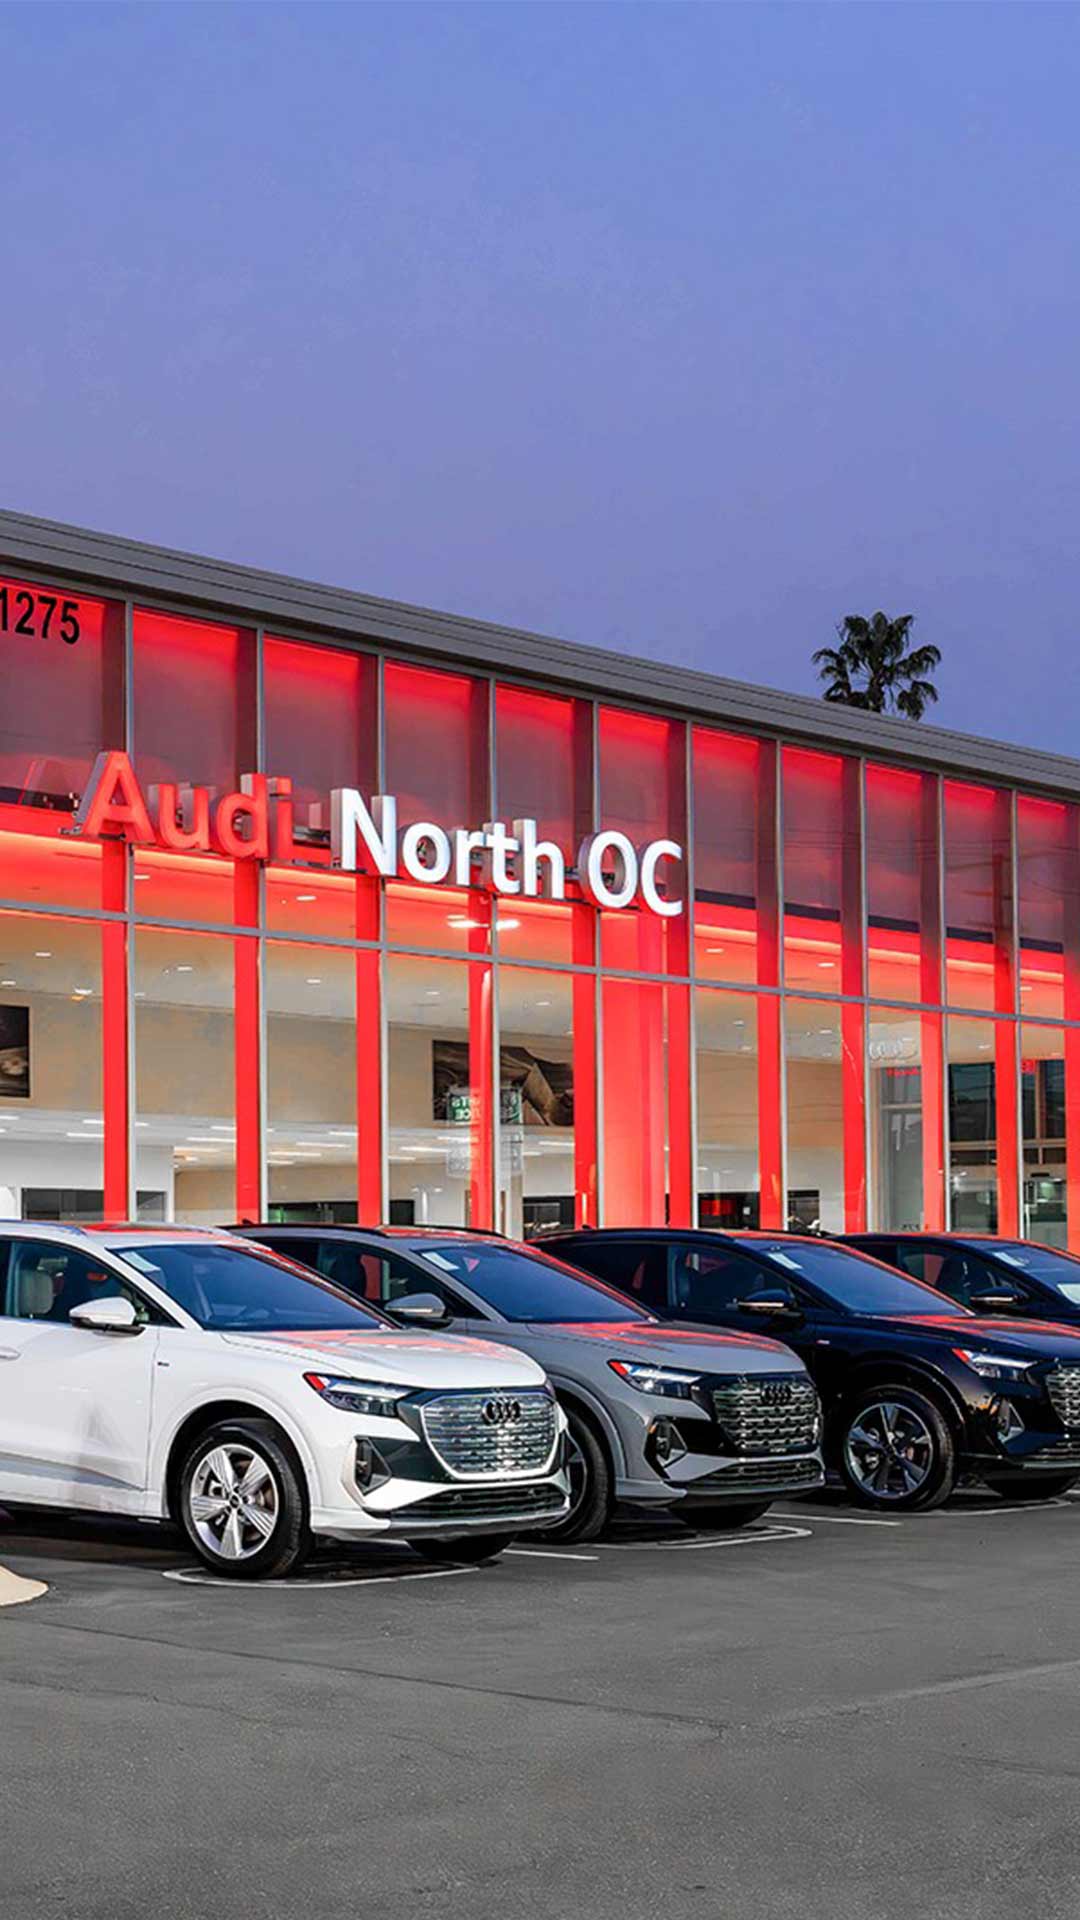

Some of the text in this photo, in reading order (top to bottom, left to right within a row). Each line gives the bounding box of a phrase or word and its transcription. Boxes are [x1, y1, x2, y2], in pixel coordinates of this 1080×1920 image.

[0, 586, 81, 645] 1275
[79, 750, 684, 917] Audi North OC
